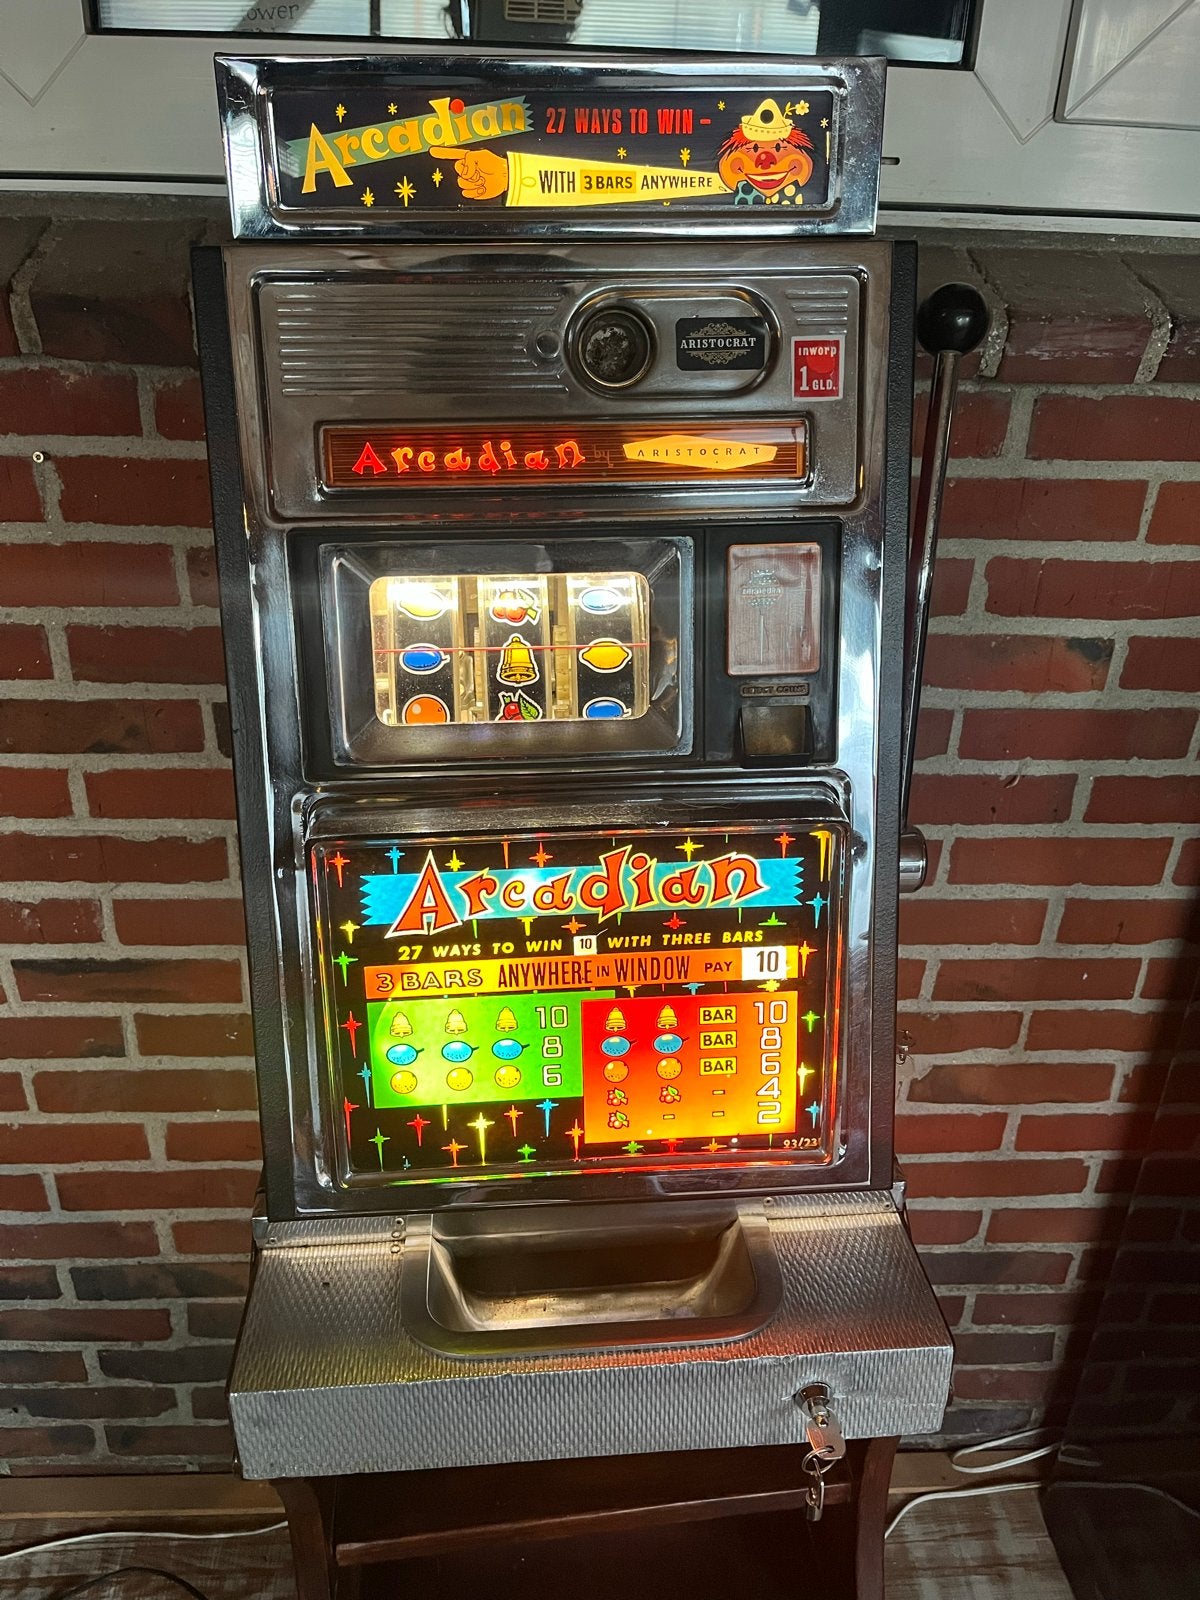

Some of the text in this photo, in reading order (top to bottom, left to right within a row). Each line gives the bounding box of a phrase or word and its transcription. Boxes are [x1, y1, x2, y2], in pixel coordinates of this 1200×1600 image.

[243, 4, 300, 20] ower
[546, 107, 567, 134] 27
[575, 108, 622, 134] WAYS
[629, 108, 648, 134] TO
[657, 108, 693, 134] WIN
[301, 97, 525, 194] Arcadian
[539, 170, 576, 194] WITH
[641, 175, 713, 190] ANYWHERE
[680, 337, 757, 349] ARISTOCRAT
[800, 366, 810, 391] 1
[351, 441, 586, 475] Arcadian
[637, 447, 760, 457] ARISTOCRAT
[384, 844, 770, 939] Arcadian
[398, 930, 764, 961] 27 WAYS TO WIN 10 WITH THREE BARS
[376, 950, 780, 992] 3 BARS ANYWHERE IN WINDOW PAY 10
[535, 1005, 569, 1030] 10
[702, 1000, 788, 1025] BAR 10
[542, 1035, 563, 1059] 8
[703, 1026, 782, 1050] BAR 8
[542, 1064, 563, 1087] 6
[703, 1052, 781, 1075] BAR 6
[756, 1076, 781, 1099] 4
[757, 1101, 781, 1124] 2
